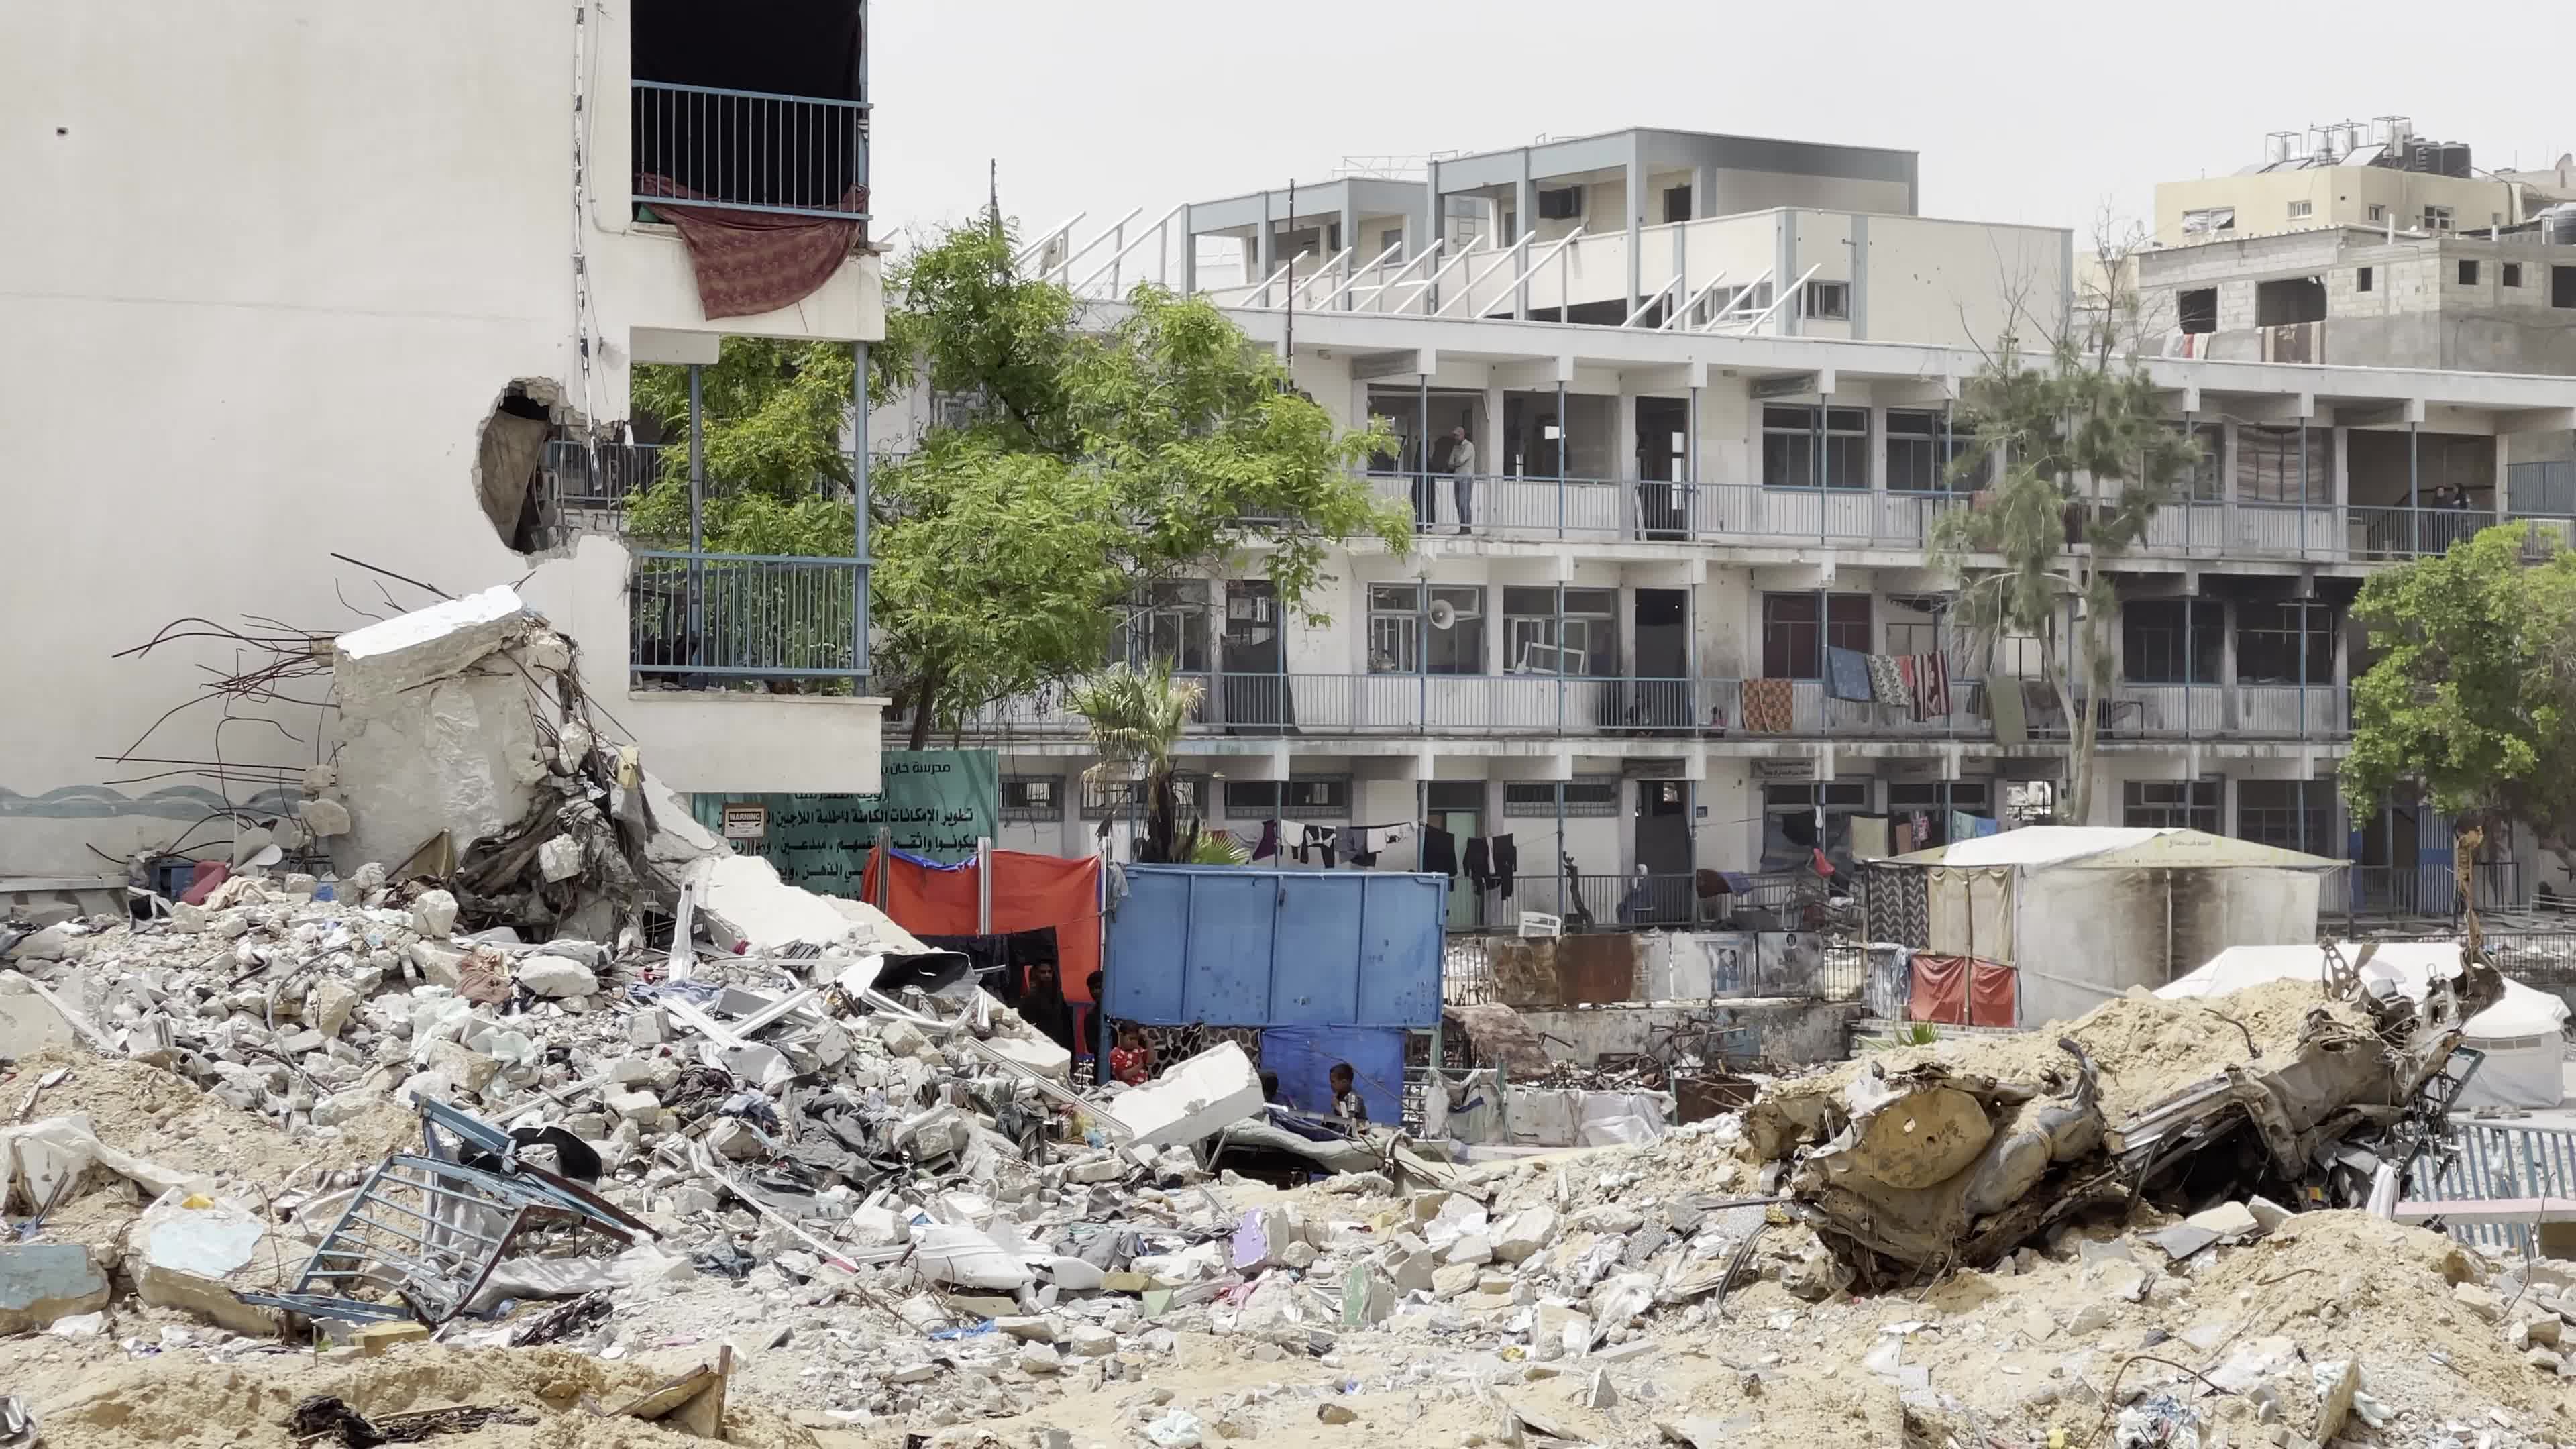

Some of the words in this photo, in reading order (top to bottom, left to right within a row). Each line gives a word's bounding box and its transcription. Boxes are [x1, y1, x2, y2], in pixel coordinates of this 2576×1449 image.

[890, 762, 909, 775] خان
[912, 761, 951, 775] مدرسة
[729, 812, 761, 821] WARNING
[853, 808, 888, 823] الكامنة
[941, 808, 973, 826] تطوير
[802, 863, 843, 880] الذهن
